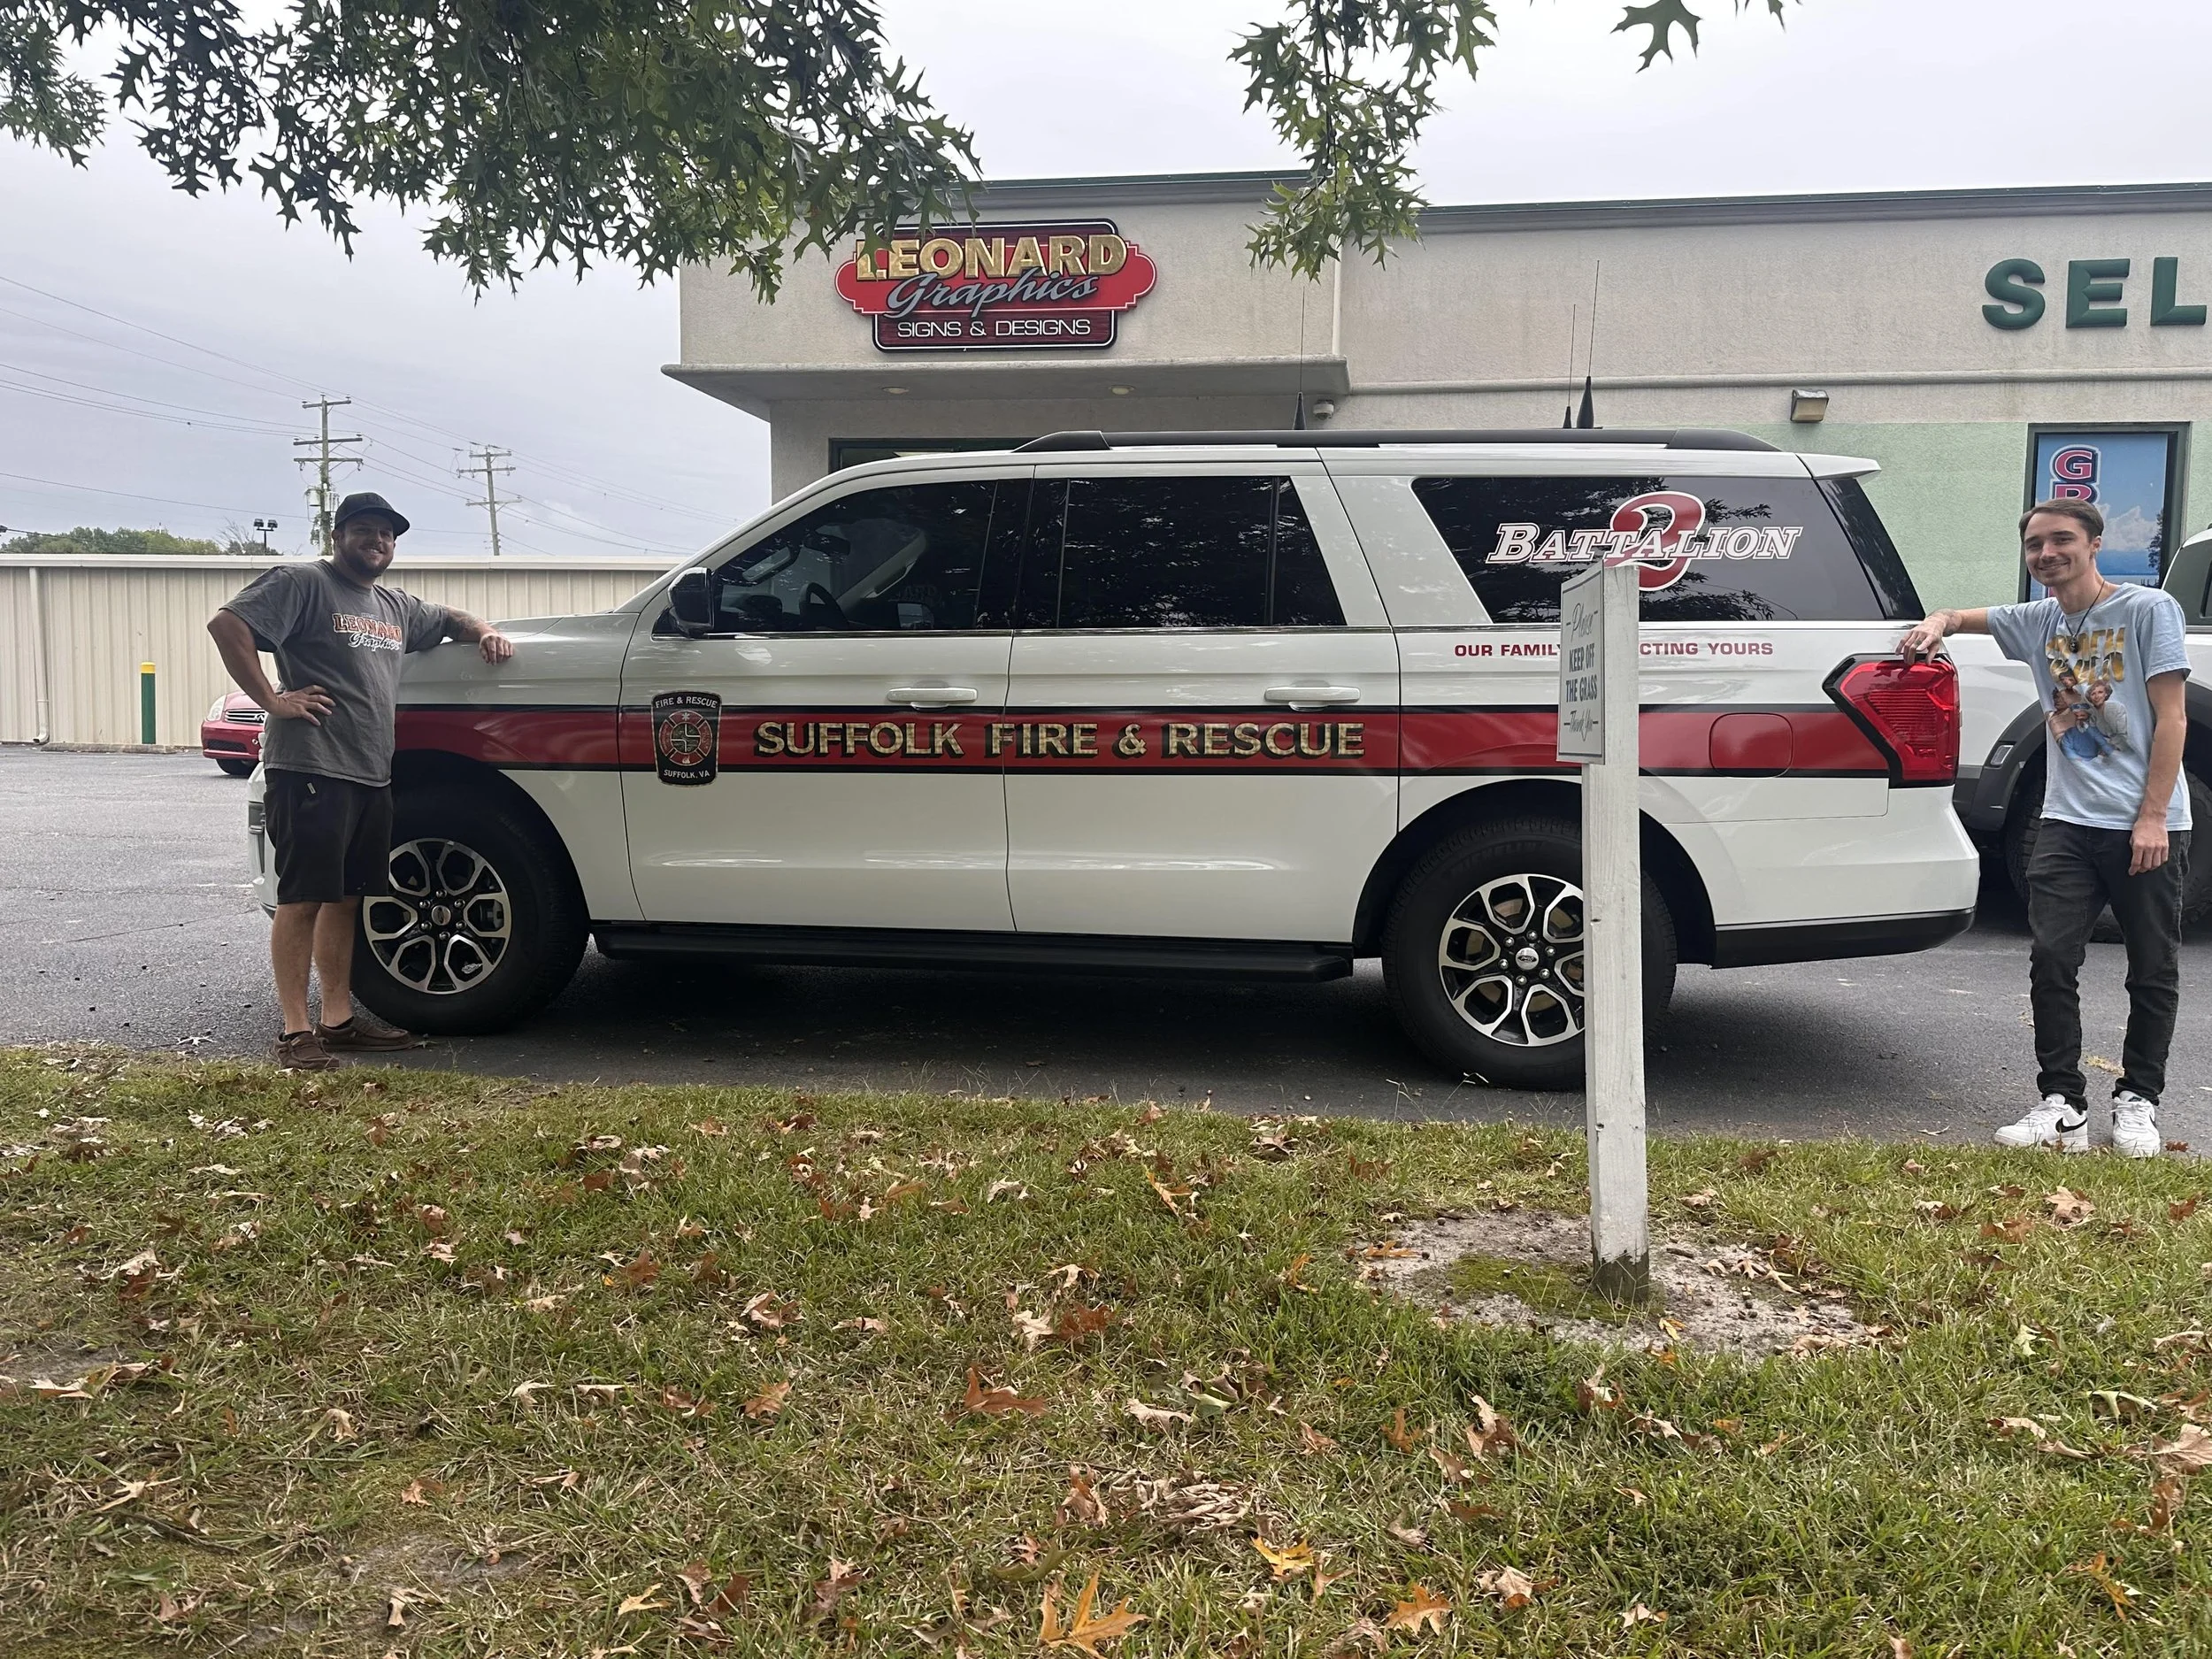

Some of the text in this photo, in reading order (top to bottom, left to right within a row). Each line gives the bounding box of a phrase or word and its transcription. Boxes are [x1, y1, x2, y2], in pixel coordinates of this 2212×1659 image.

[856, 234, 1127, 280] LEONARD
[885, 266, 1100, 319] Graphics
[897, 319, 1091, 338] SIGNS & DESIGNS
[1486, 523, 1803, 565] BATTALION
[1571, 603, 1594, 642] Please
[348, 632, 400, 652] Graphics
[1454, 642, 1773, 657] OUR FAMIL CTING YOURS
[1569, 643, 1594, 672] KEEP OFF
[655, 697, 674, 709] FIRE
[686, 695, 718, 709] RESCUE
[1565, 674, 1597, 703] THE GRASS
[1569, 710, 1584, 733] Thank
[757, 721, 1365, 757] SUFFOLK FIRE & RESCUE
[698, 769, 710, 778] VA
